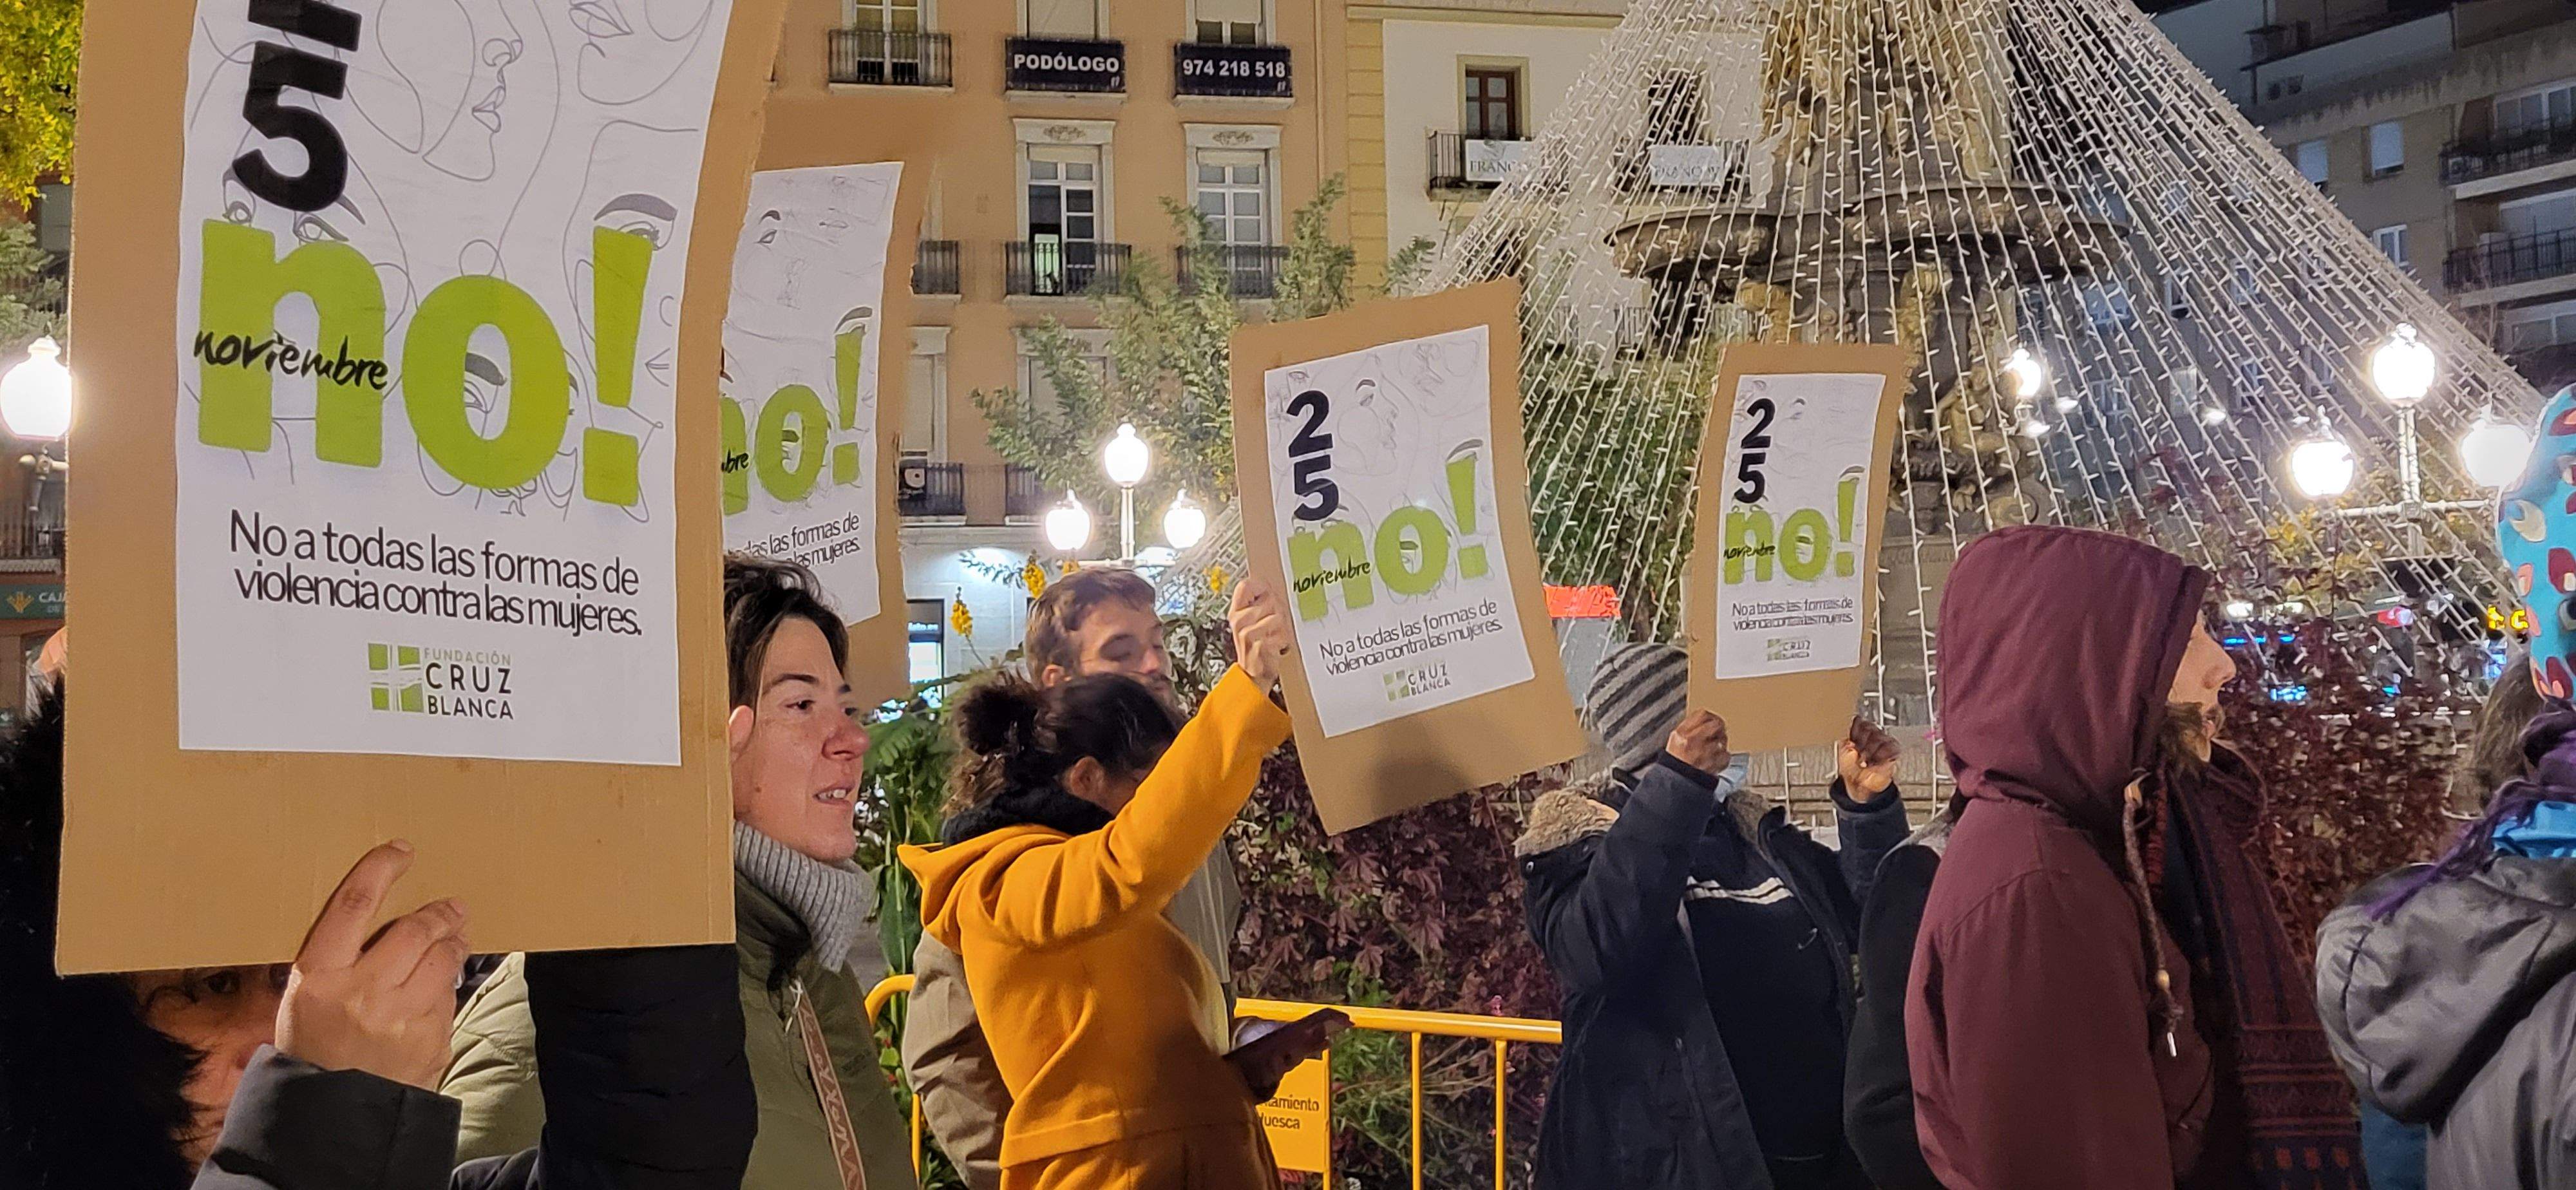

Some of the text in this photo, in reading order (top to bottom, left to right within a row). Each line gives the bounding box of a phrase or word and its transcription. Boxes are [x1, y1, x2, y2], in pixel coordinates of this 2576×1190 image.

[1014, 51, 1120, 73] PODÓLOGO
[1182, 59, 1285, 78] 974 218 518
[232, 41, 348, 212] 5
[194, 331, 388, 390] noviembre
[198, 219, 653, 507] no!
[1286, 390, 1333, 457] 2
[1740, 397, 1776, 449] 2
[1291, 454, 1340, 521] 5
[1734, 452, 1766, 504] 5
[231, 509, 639, 596] No a todas las formas de
[769, 534, 790, 554] las
[791, 525, 840, 548] formas
[843, 511, 860, 534] de
[1287, 458, 1489, 622] no!
[1724, 480, 1857, 585] no!
[1293, 555, 1370, 592] noviembre
[234, 559, 642, 637] violencia contra las mujeres.
[1732, 602, 1748, 617] No
[1320, 597, 1497, 660] No a todas las formas de
[424, 648, 511, 665] FUNDACIÓN
[1326, 647, 1385, 675] violencia
[1385, 639, 1428, 659] contra
[1428, 632, 1447, 649] las
[1408, 661, 1447, 685] CRUZ
[426, 662, 512, 694] CRUZ
[1410, 677, 1451, 696] BLANCA
[427, 695, 514, 720] BLANCA
[1265, 1094, 1320, 1111] amiento
